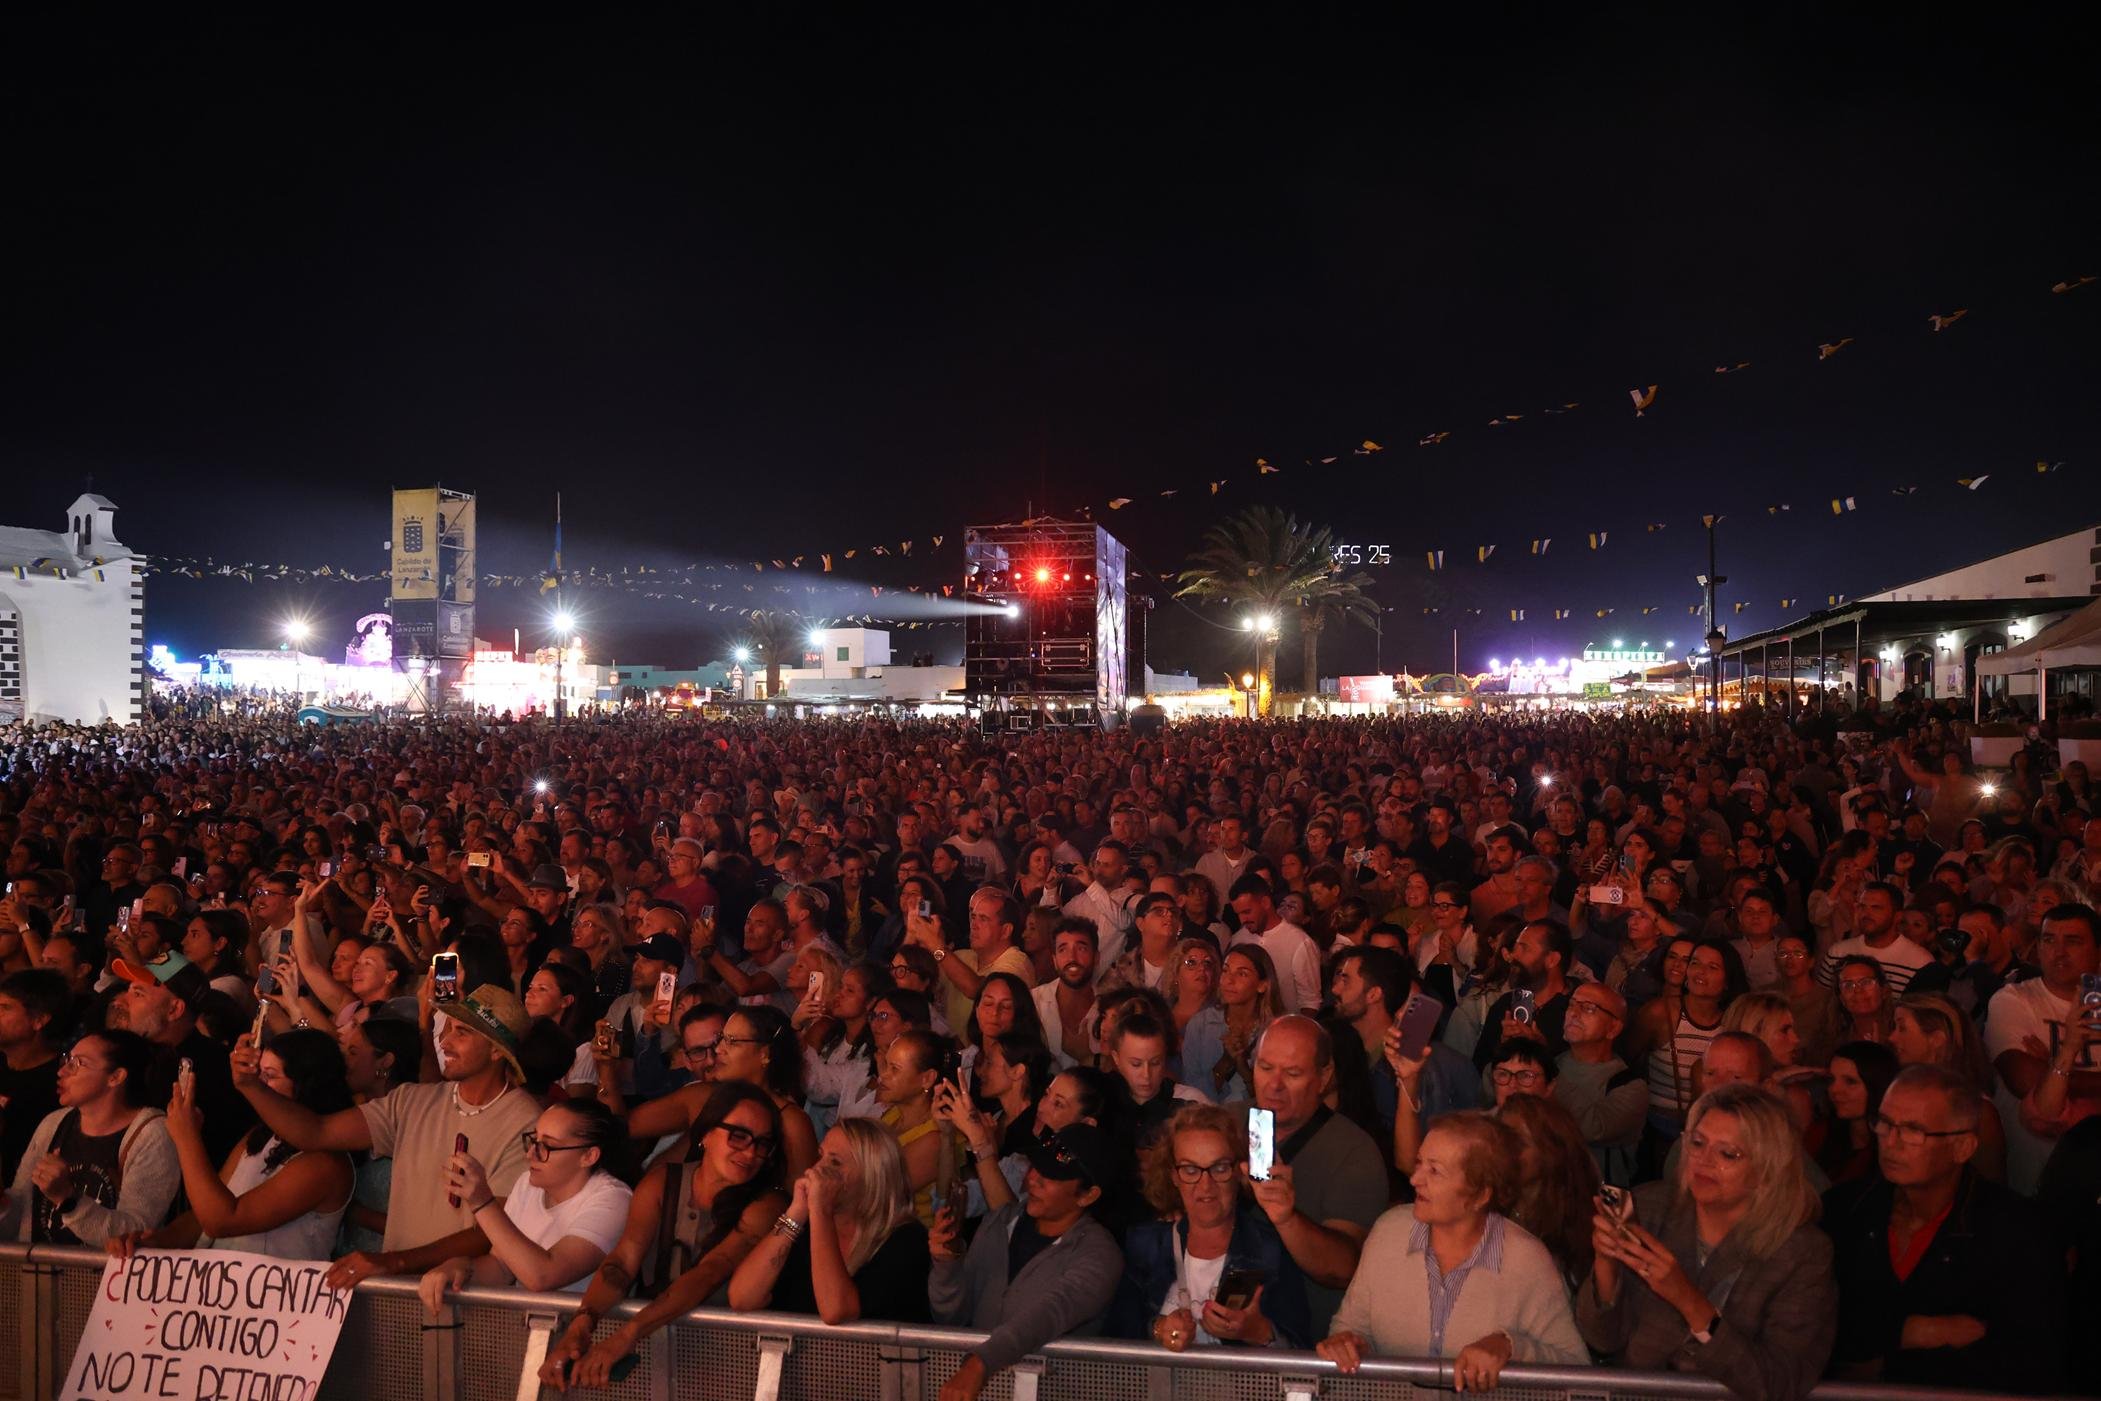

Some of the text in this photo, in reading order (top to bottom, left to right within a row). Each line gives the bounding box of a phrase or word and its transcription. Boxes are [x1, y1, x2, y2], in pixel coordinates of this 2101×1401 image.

[398, 566, 431, 574] Lanzar
[1368, 545, 1390, 564] 25
[245, 1264, 348, 1324] CANTAR
[160, 1310, 279, 1359] CONTIGO
[78, 1351, 135, 1394] NO
[141, 1354, 181, 1397] TE
